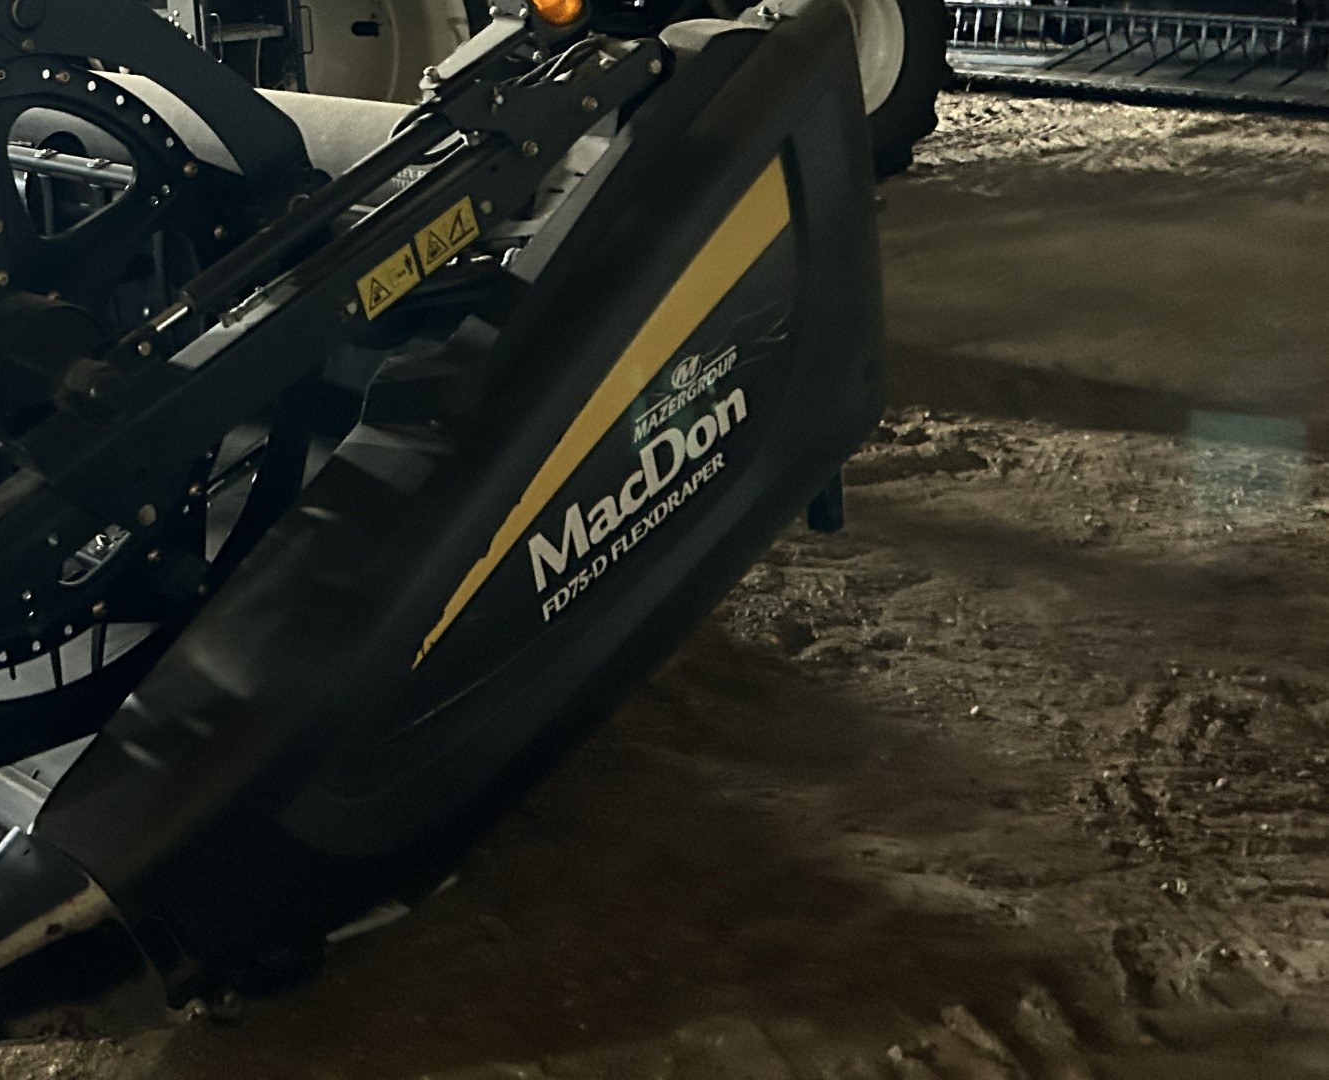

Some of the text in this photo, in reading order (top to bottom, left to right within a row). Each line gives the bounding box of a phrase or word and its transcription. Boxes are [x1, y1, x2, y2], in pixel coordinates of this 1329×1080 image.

[633, 351, 738, 443] MAZERGROUP
[527, 387, 748, 592] MacDon
[541, 452, 725, 622] FD75-D FLEXDRAPER
